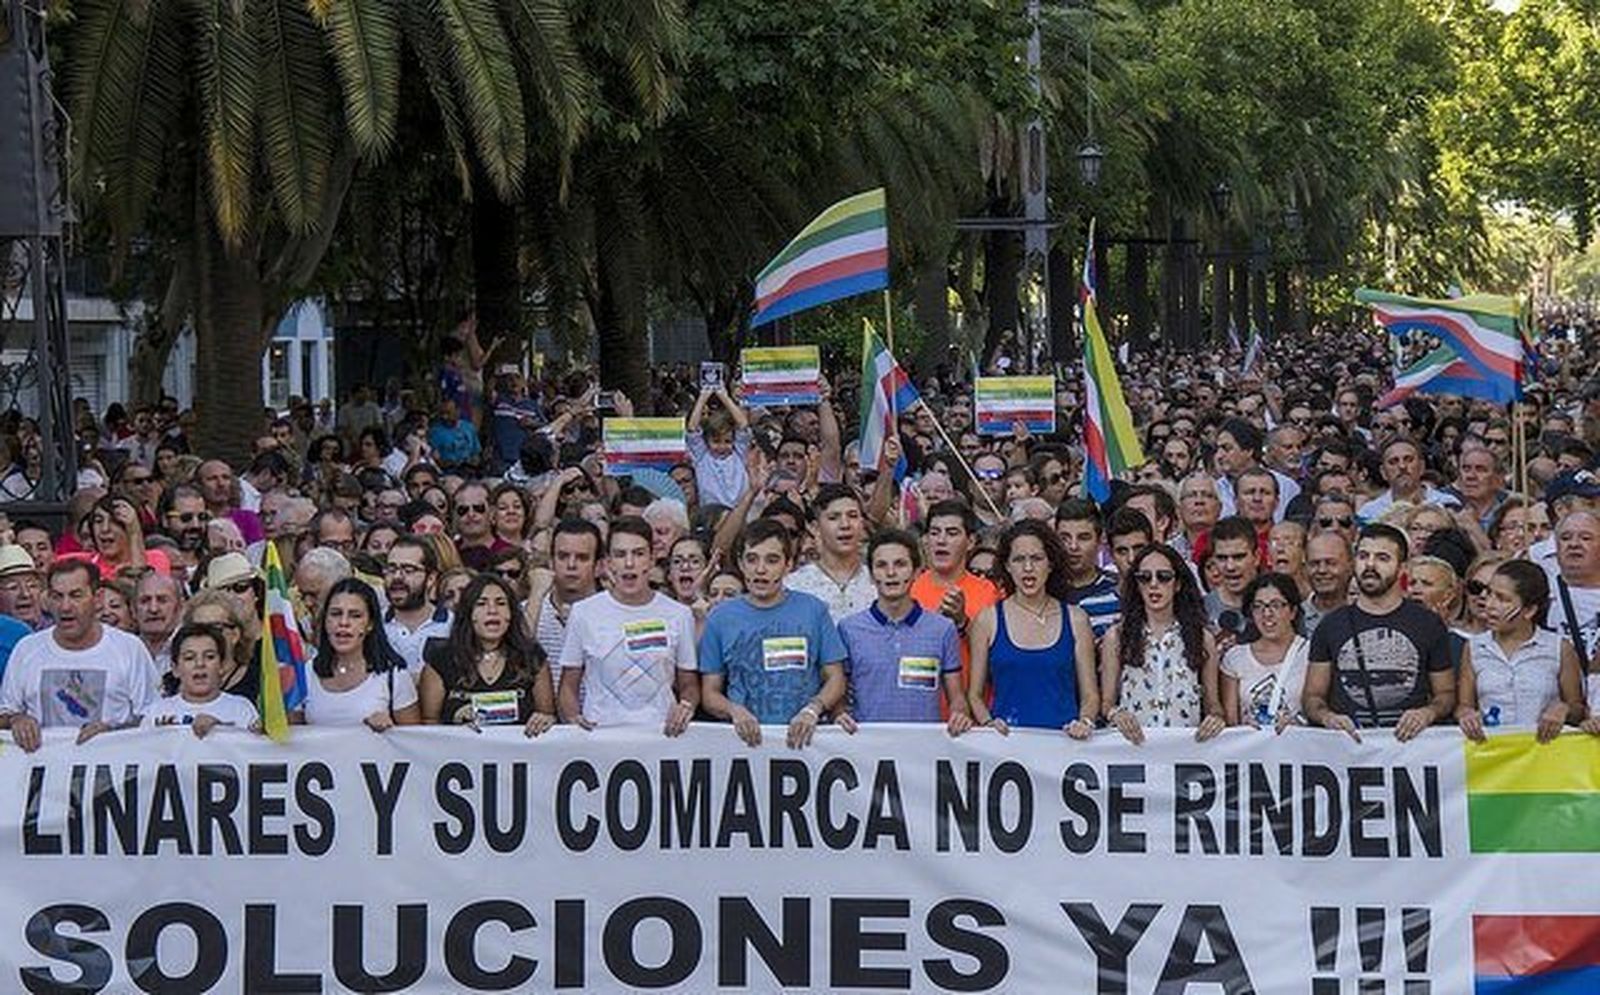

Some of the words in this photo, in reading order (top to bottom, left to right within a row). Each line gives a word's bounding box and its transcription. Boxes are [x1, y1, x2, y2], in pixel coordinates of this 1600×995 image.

[23, 762, 336, 857] LINARES
[360, 762, 410, 855] Y
[434, 763, 528, 854] SU
[556, 758, 910, 852] COMARCA
[936, 760, 1033, 853] NO
[1060, 763, 1146, 854] SE
[1175, 763, 1442, 858] RINDEN
[19, 897, 1010, 995] SOLUCIONES
[1060, 903, 1256, 995] YA
[1311, 907, 1430, 995] !!!
